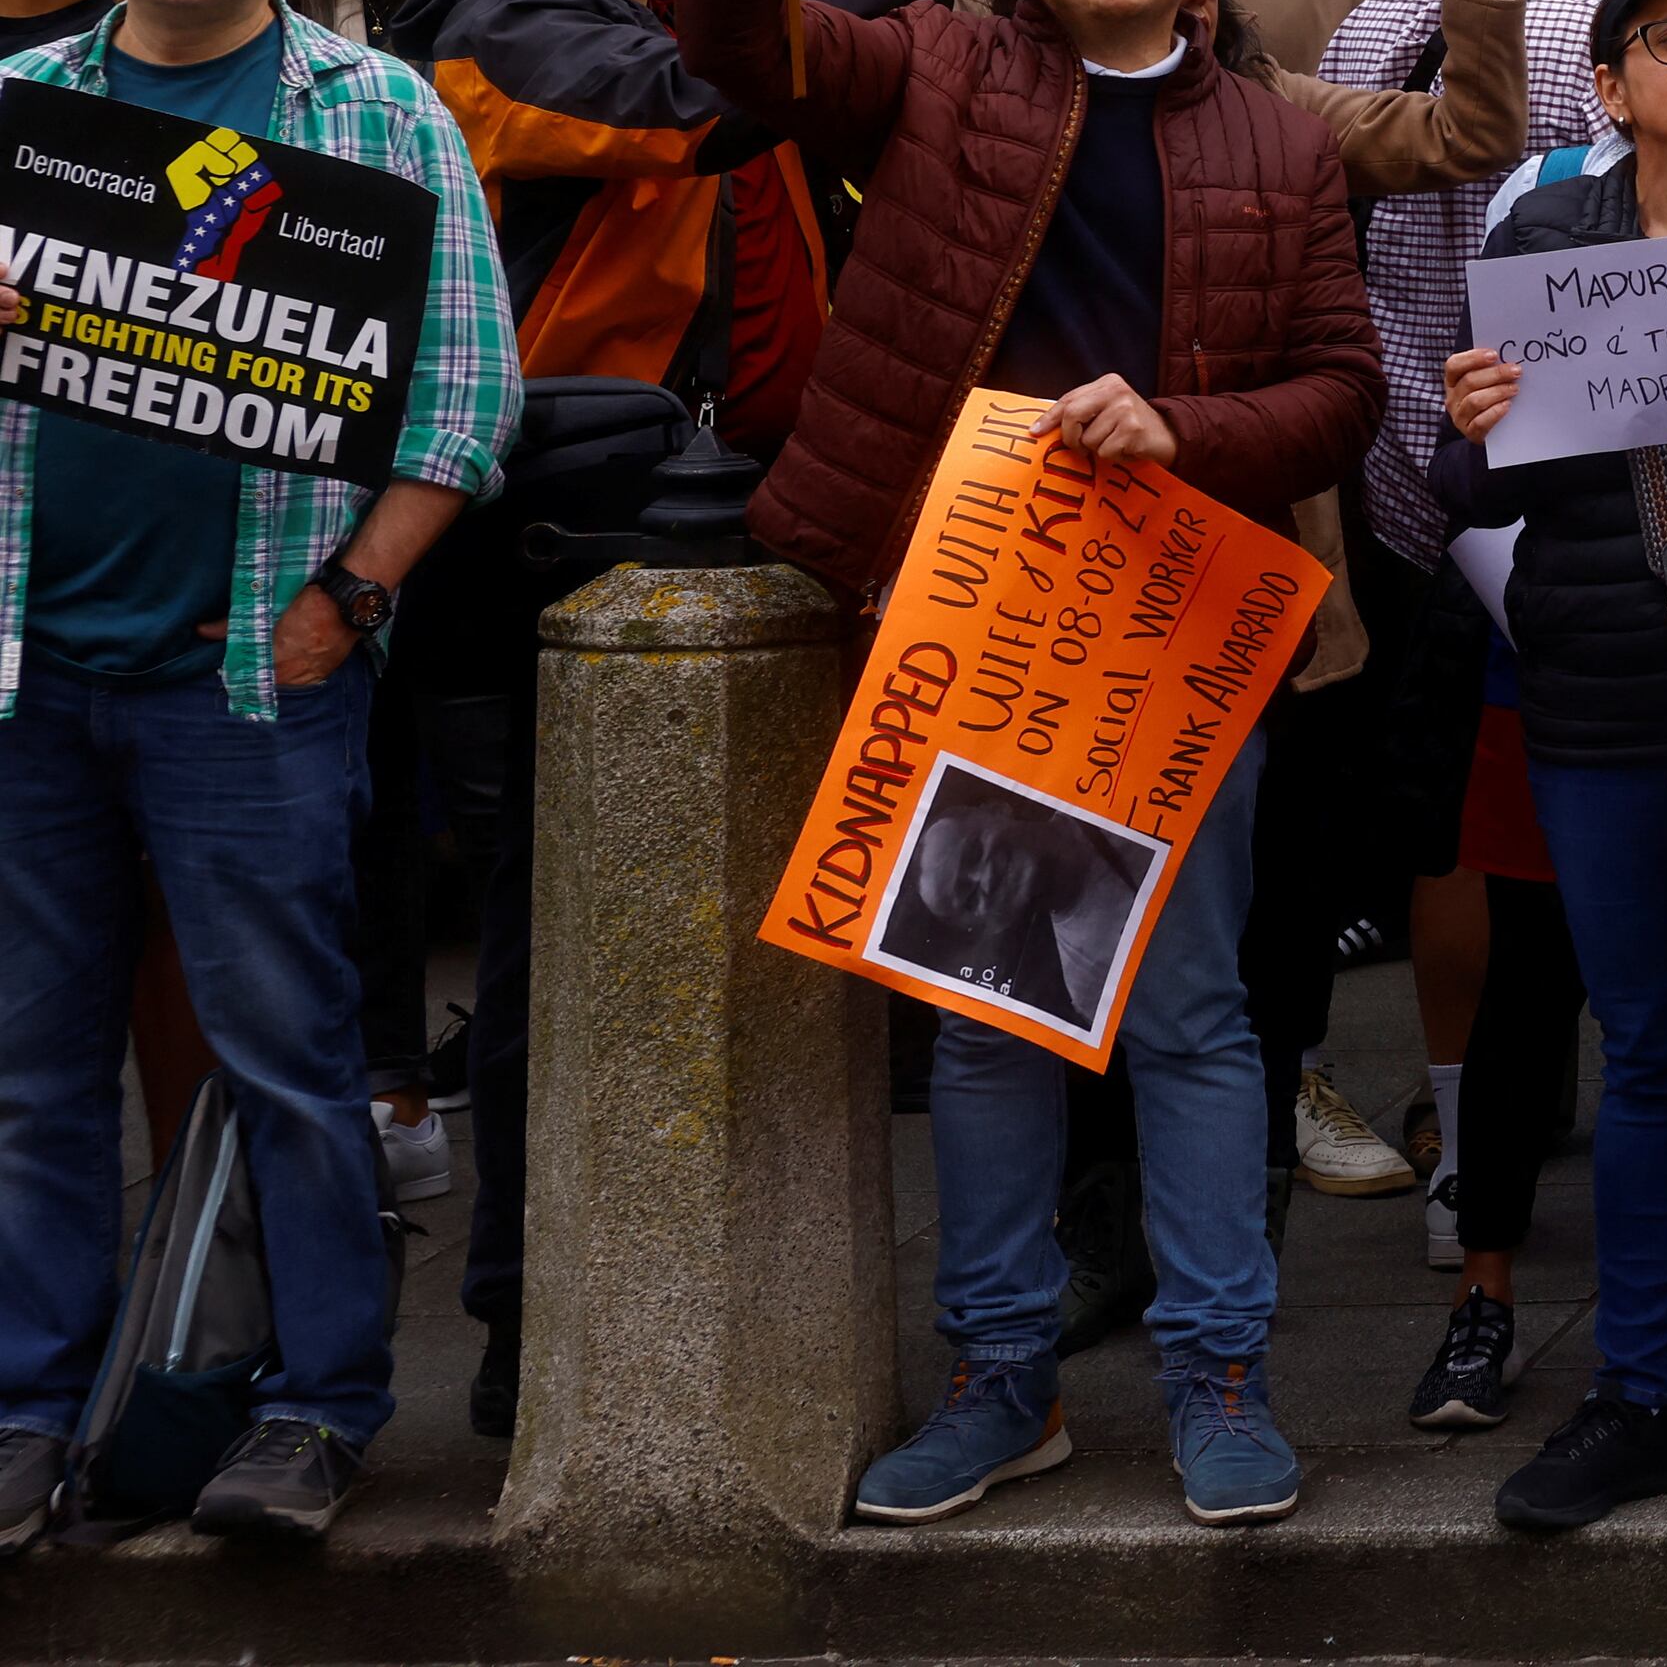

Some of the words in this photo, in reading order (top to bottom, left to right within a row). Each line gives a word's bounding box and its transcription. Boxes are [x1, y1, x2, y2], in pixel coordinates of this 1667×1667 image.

[14, 144, 157, 204] Democracia
[279, 212, 386, 261] Libertad!
[0, 225, 390, 379] VENEZUELA
[40, 303, 218, 374] FIGHTING
[227, 351, 306, 396] FOR
[312, 372, 374, 413] ITS
[1499, 328, 1586, 364] COÑO
[0, 333, 344, 465] FREEDOM
[972, 401, 1044, 465] HIS
[928, 479, 1020, 610] WITH
[958, 601, 1048, 732] WIFE
[1018, 689, 1069, 756] ON
[788, 640, 958, 949] KIDNAPPED
[1127, 717, 1221, 846] FRANK
